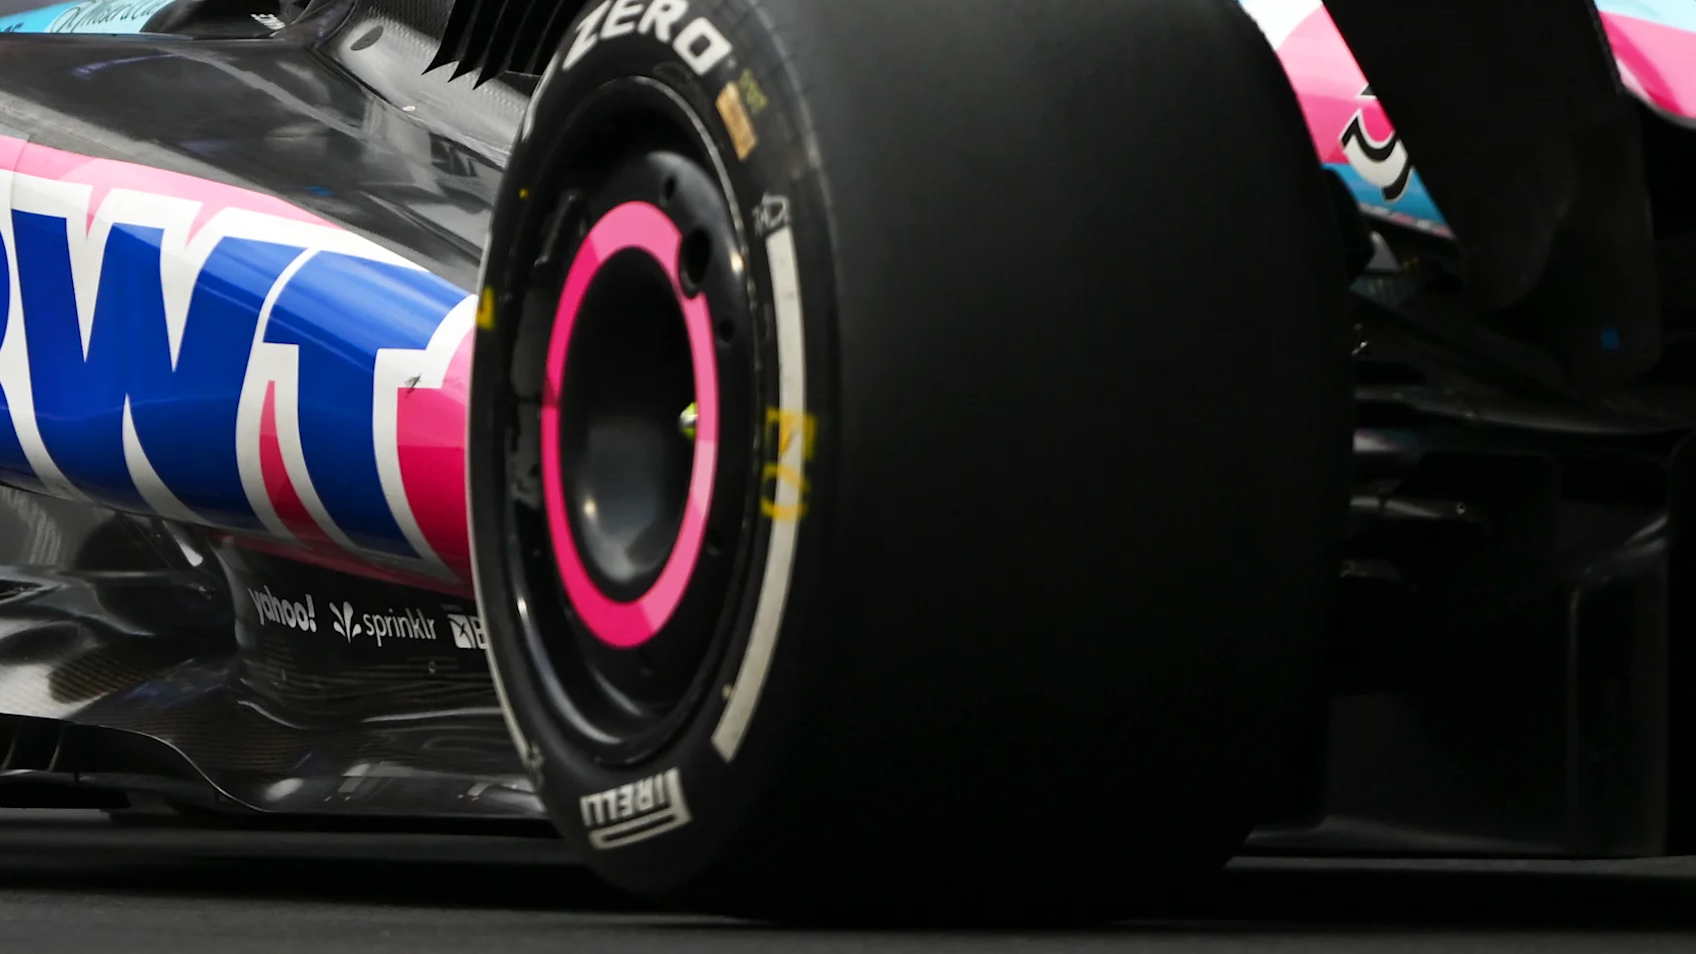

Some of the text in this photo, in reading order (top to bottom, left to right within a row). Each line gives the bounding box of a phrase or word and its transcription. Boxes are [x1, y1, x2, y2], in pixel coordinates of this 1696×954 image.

[248, 584, 317, 633] yahoo!
[362, 607, 436, 647] sprinklr
[579, 767, 692, 849] PIRELLI
